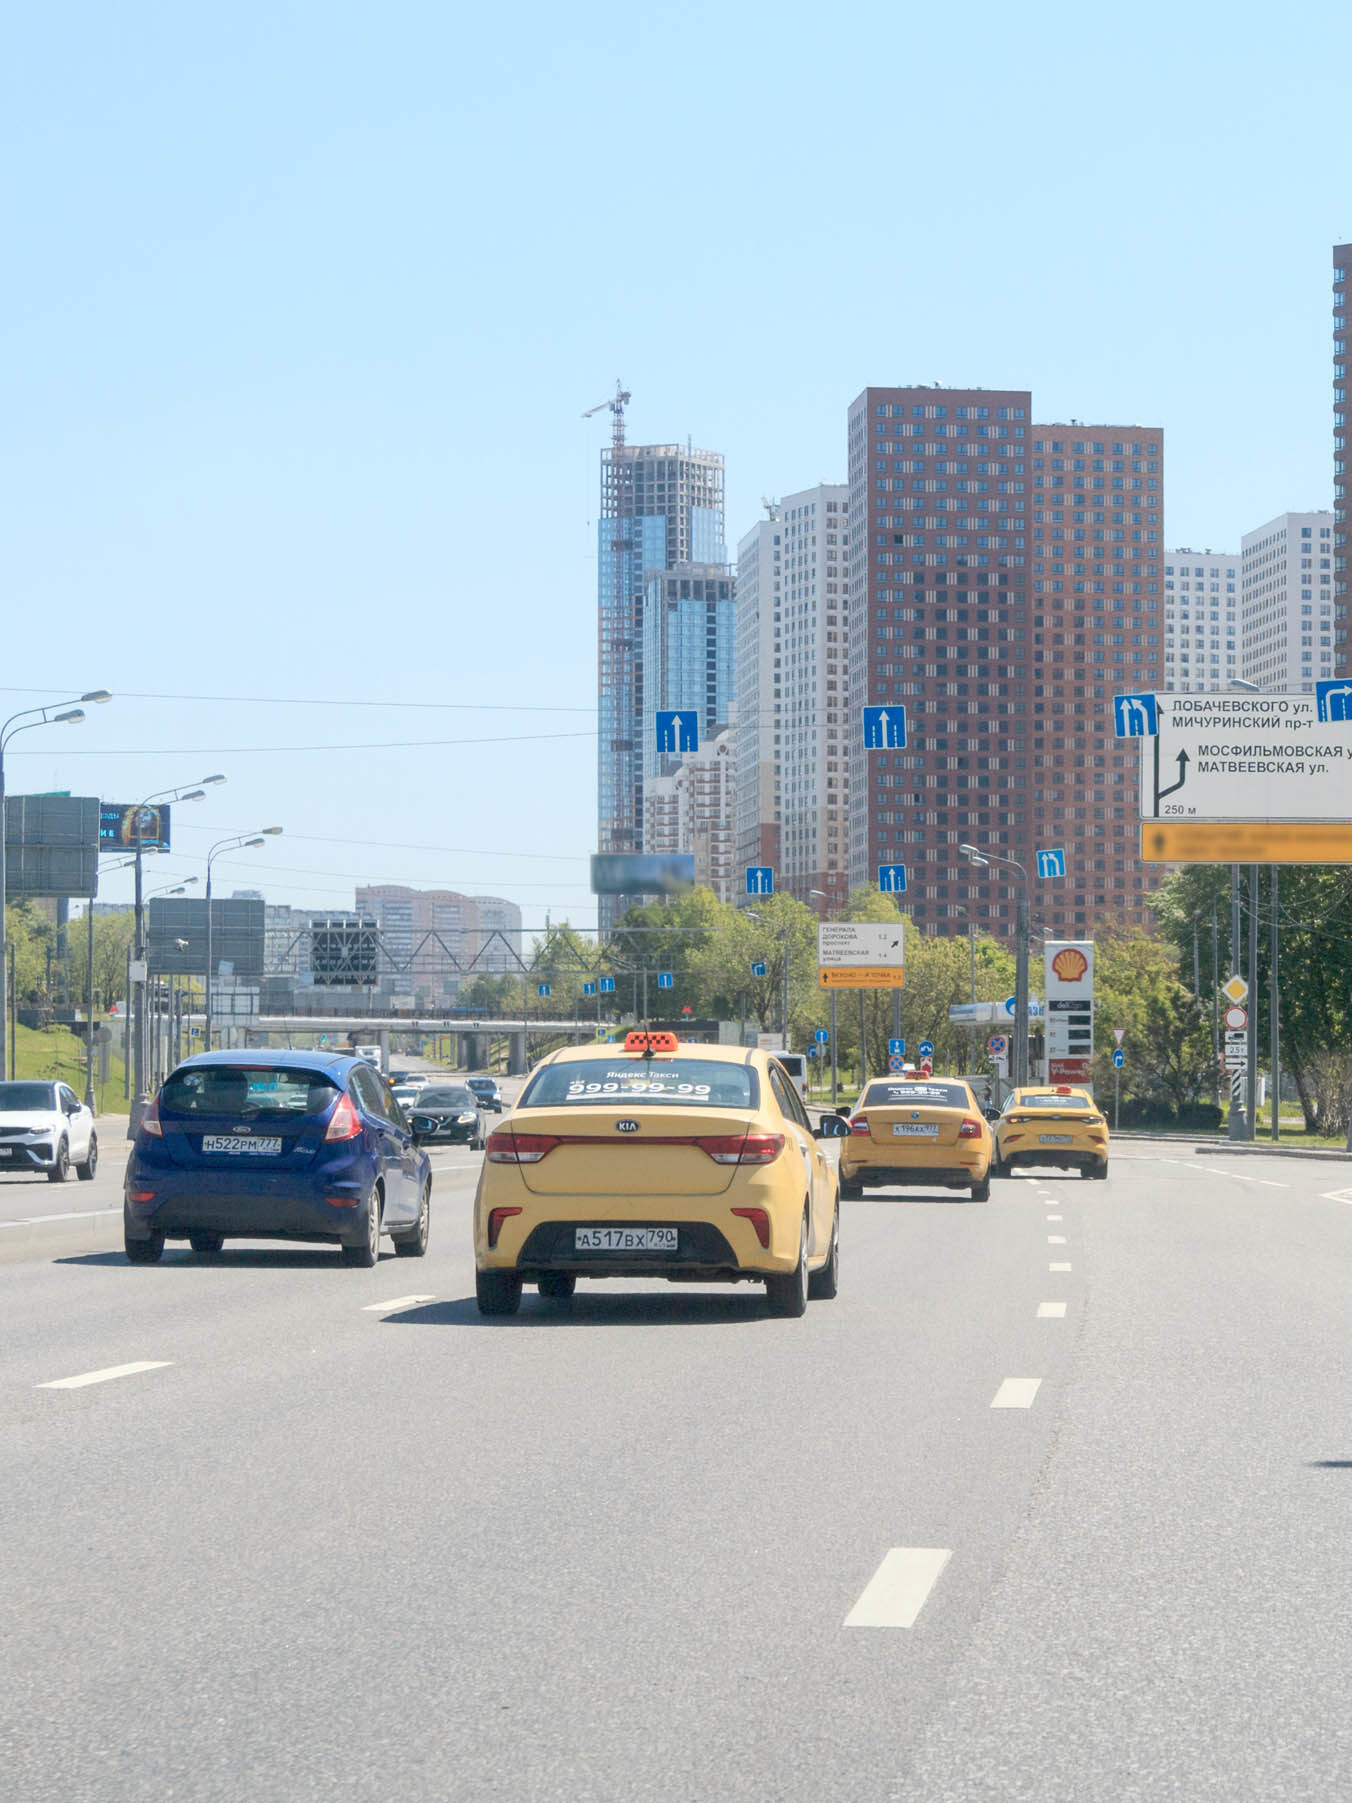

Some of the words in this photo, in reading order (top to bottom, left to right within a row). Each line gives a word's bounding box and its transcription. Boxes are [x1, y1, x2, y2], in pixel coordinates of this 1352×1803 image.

[1172, 700, 1289, 713] ЛОБАЧЕВСКОГО
[1292, 703, 1313, 715] ул.
[1172, 714, 1281, 729] МИЧУРИНСКИЙ
[1284, 719, 1314, 731] пр-т
[1198, 744, 1343, 758] МОСФИЛЬМОВСКАЯ
[1198, 761, 1305, 774] МАТВЕЕВСКАЯ
[1308, 764, 1329, 775] ул.
[1164, 805, 1185, 815] 250
[1188, 807, 1196, 815] м
[606, 1071, 646, 1079] Яндекс
[649, 1071, 679, 1079] Такси
[568, 1082, 711, 1095] 999-99-99
[618, 1122, 637, 1131] KIA
[580, 1231, 645, 1248] А517ВХ
[648, 1229, 673, 1242] 790
